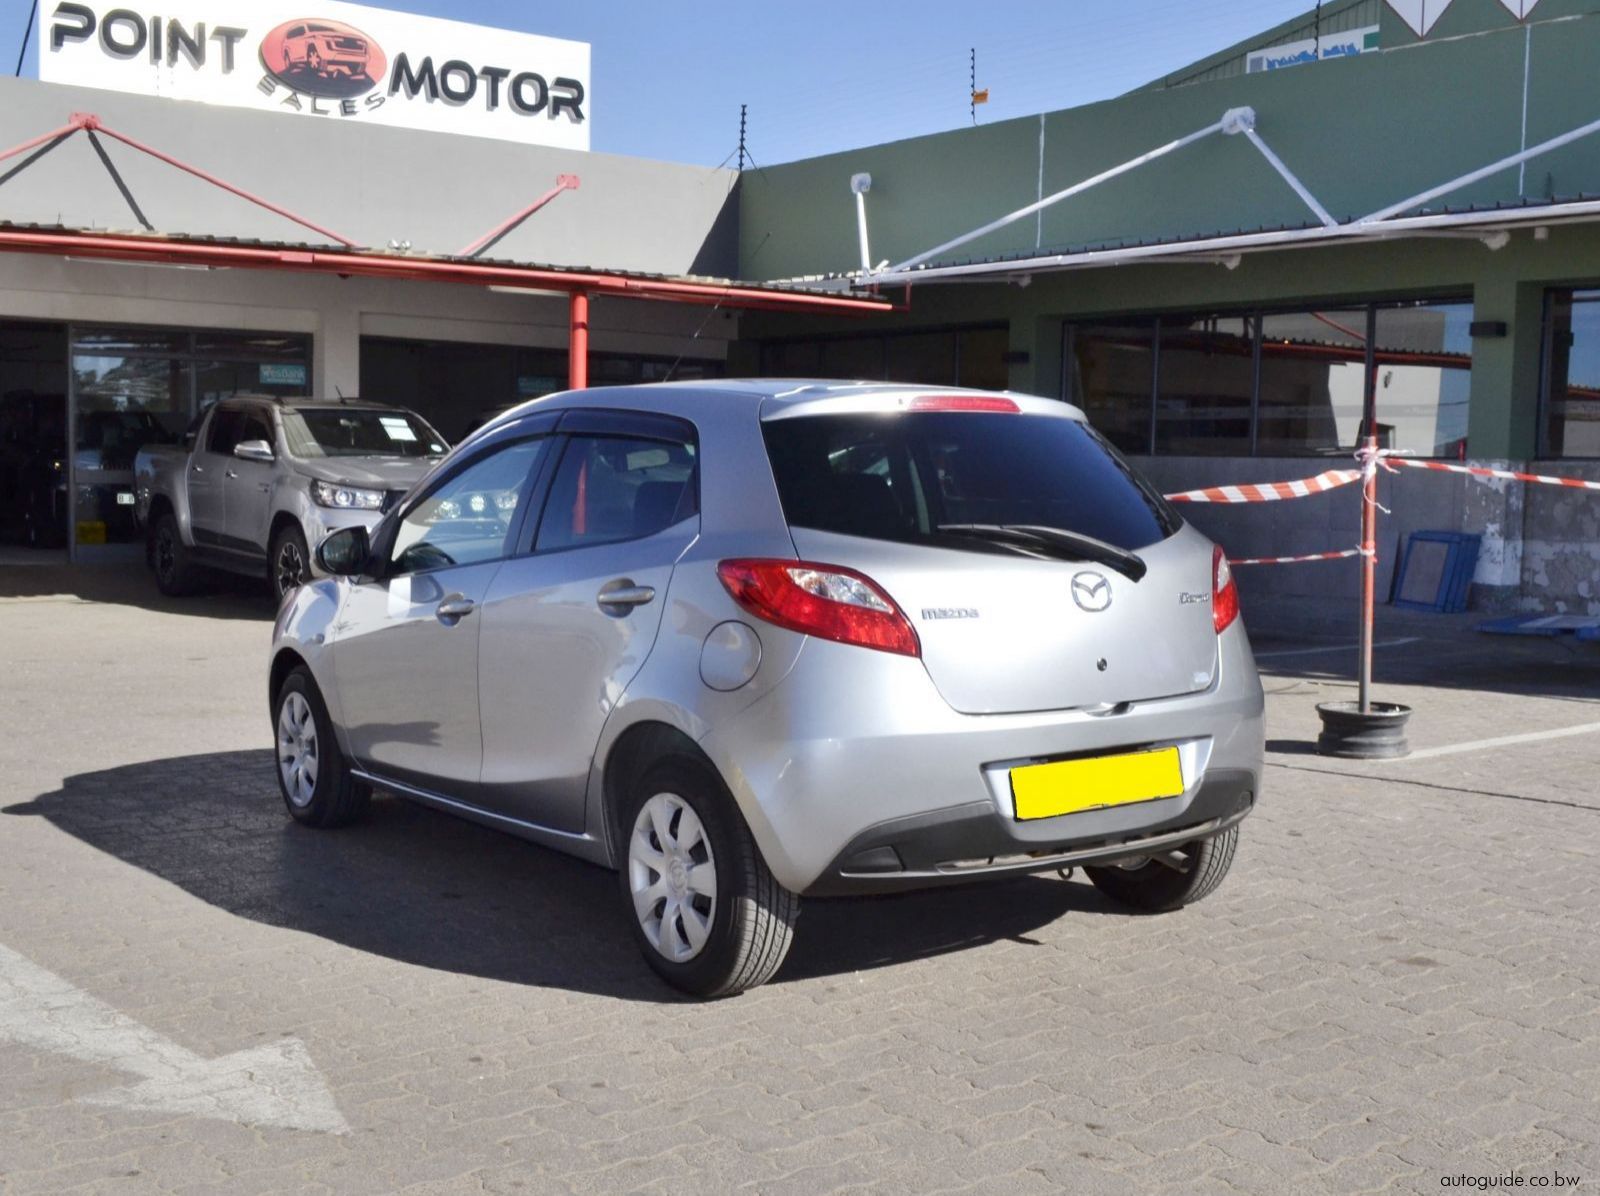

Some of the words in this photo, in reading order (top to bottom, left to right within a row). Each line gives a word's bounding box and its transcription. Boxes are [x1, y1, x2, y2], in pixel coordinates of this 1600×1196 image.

[50, 1, 248, 75] POINT
[388, 51, 585, 124] MOTOR
[257, 75, 386, 117] SALES
